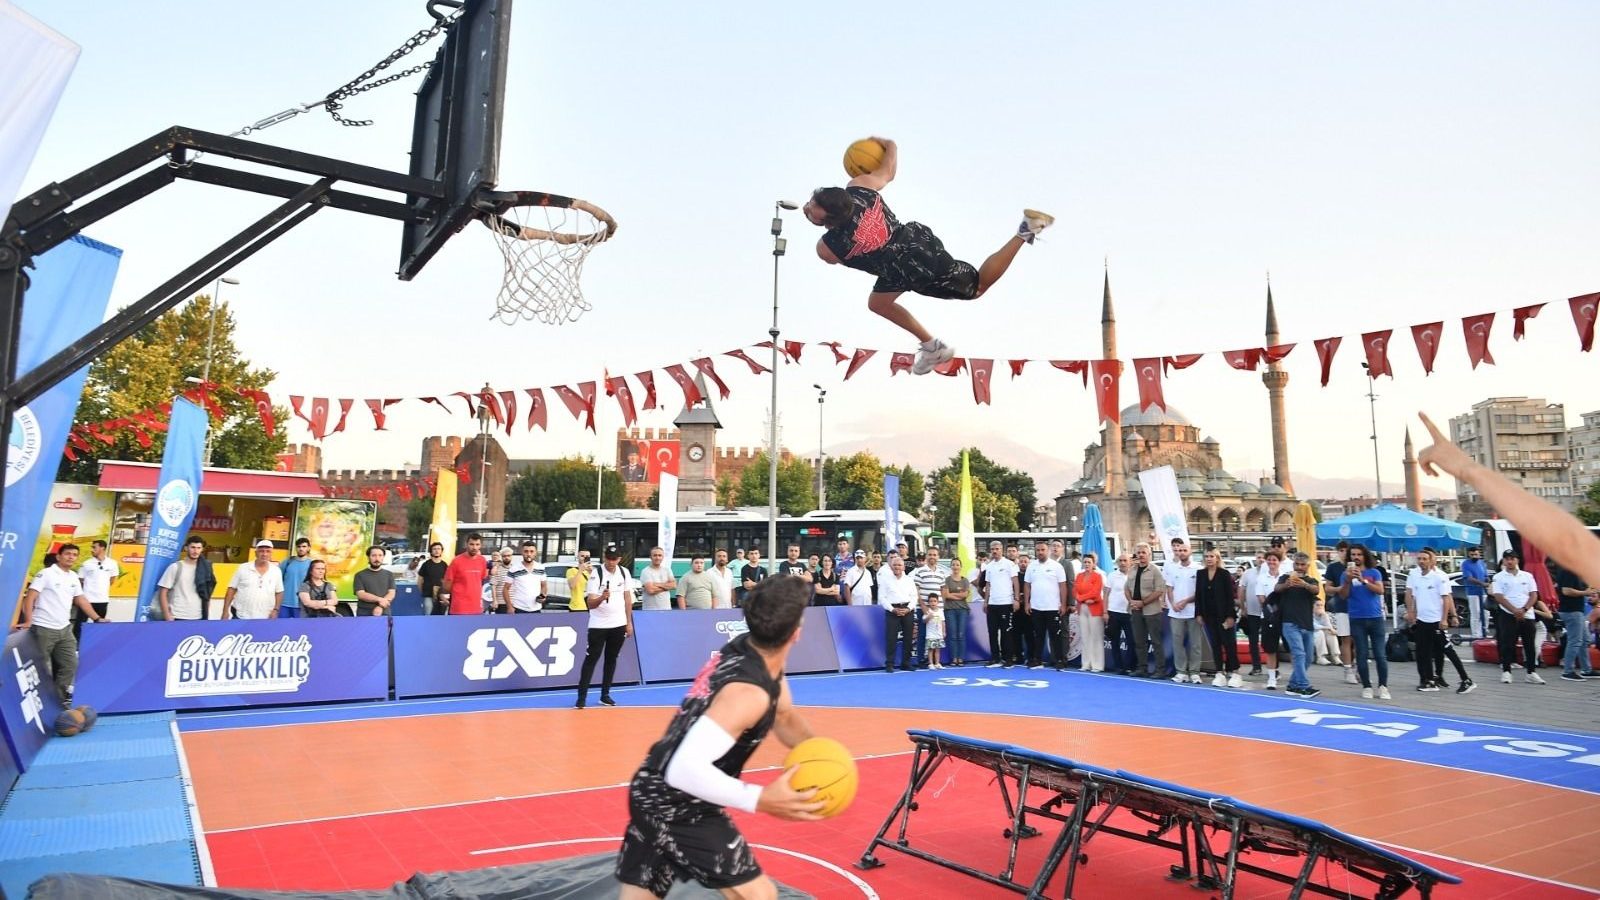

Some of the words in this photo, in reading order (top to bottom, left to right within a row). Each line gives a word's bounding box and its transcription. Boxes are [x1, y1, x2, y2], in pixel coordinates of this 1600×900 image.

[179, 636, 213, 659] Dr.
[217, 635, 308, 656] Memduh
[179, 655, 308, 682] BÜYÜKKILIÇ
